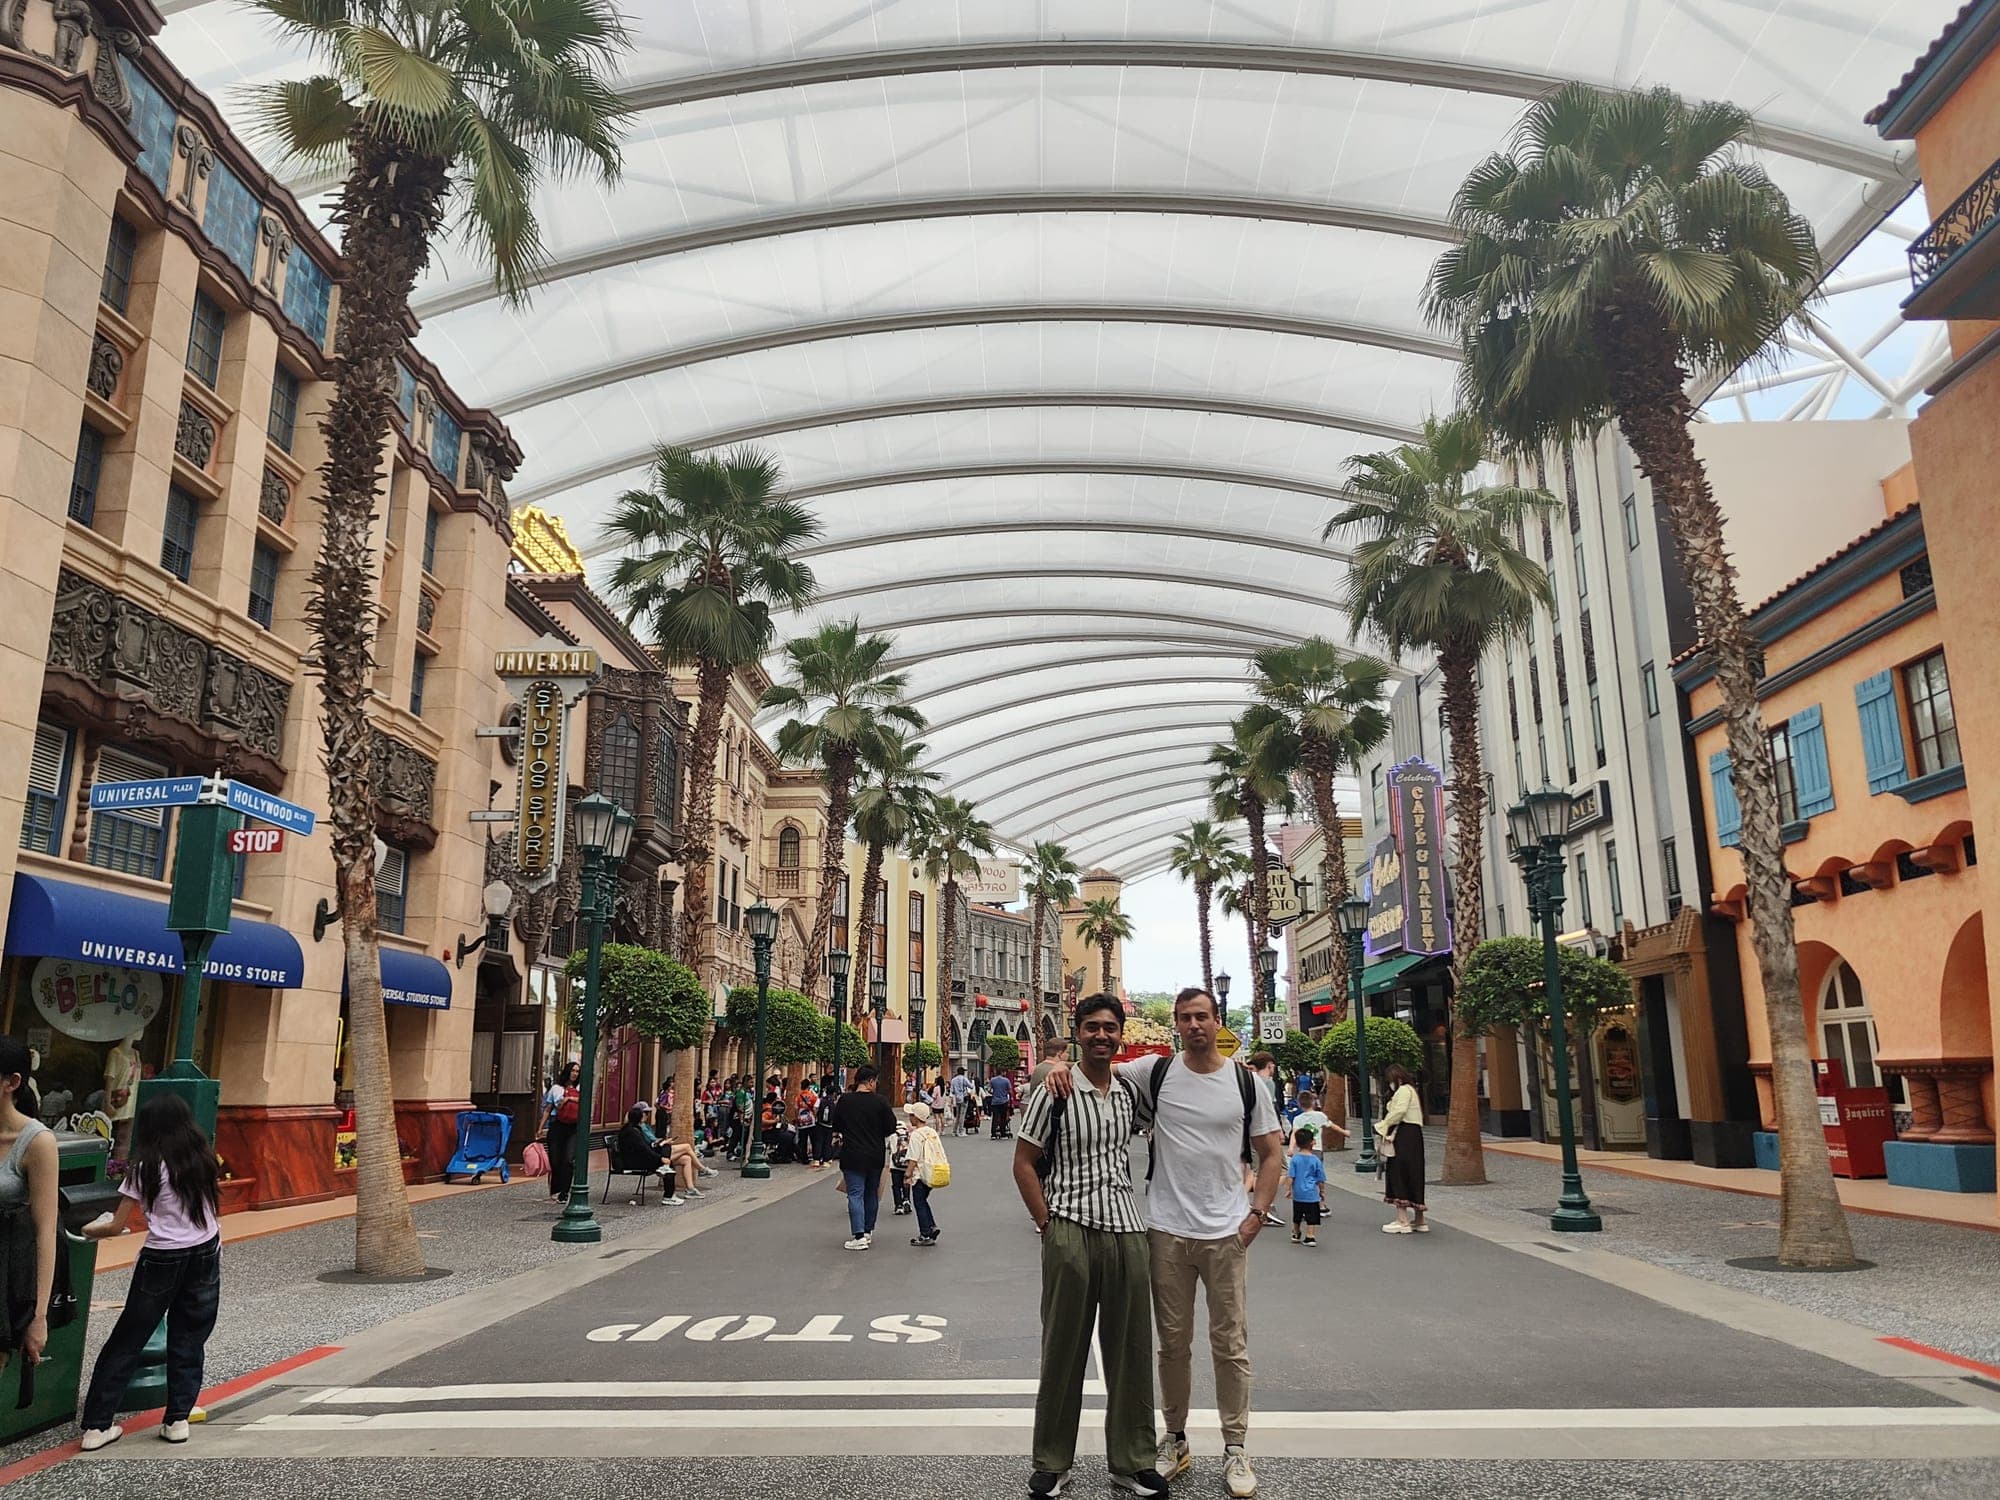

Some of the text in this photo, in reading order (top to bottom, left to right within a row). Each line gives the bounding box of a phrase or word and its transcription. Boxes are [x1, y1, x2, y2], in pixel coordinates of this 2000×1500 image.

[496, 652, 590, 671] UNIVERSAL
[525, 690, 550, 867] STUDIOS STORE
[1395, 773, 1436, 783] Celebrity
[98, 784, 194, 802] UNIVERSAL PLAZA
[234, 789, 292, 822] HOLLYWOOD
[233, 830, 280, 852] STOP
[1417, 866, 1435, 952] BAKERY
[82, 941, 287, 983] UNIVERSAL UDIOS STORE
[406, 992, 429, 1004] STUDIOS
[430, 995, 448, 1006] STORE
[1264, 1028, 1283, 1039] 30
[585, 1314, 948, 1344] STOP
